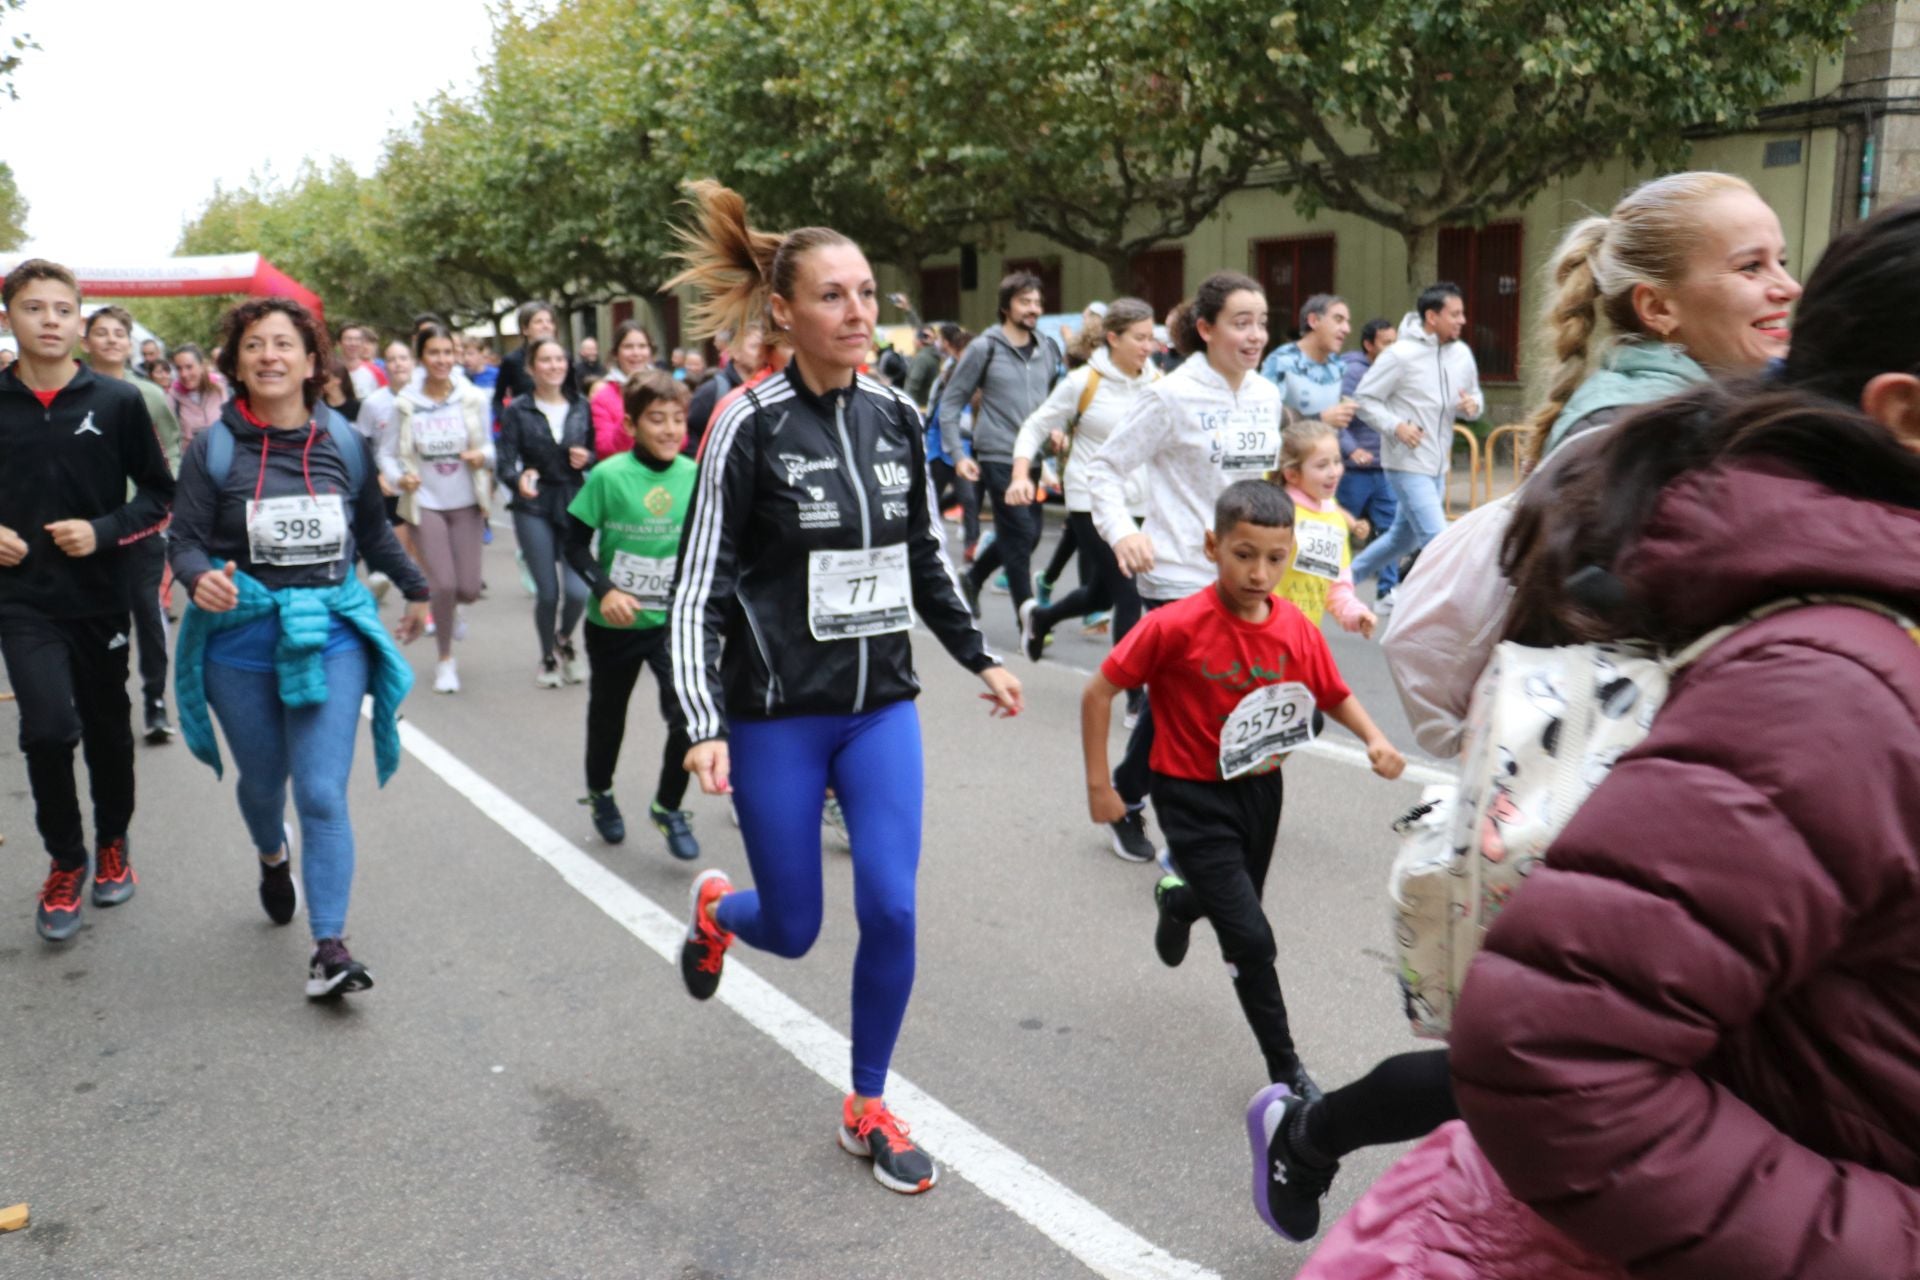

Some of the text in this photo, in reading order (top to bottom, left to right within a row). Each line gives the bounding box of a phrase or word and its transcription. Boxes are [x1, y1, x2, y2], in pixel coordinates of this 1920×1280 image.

[1237, 431, 1266, 451] 397
[274, 518, 322, 542] 398
[1305, 536, 1338, 561] 3580
[847, 575, 878, 605] 77
[1236, 702, 1296, 744] 2579
